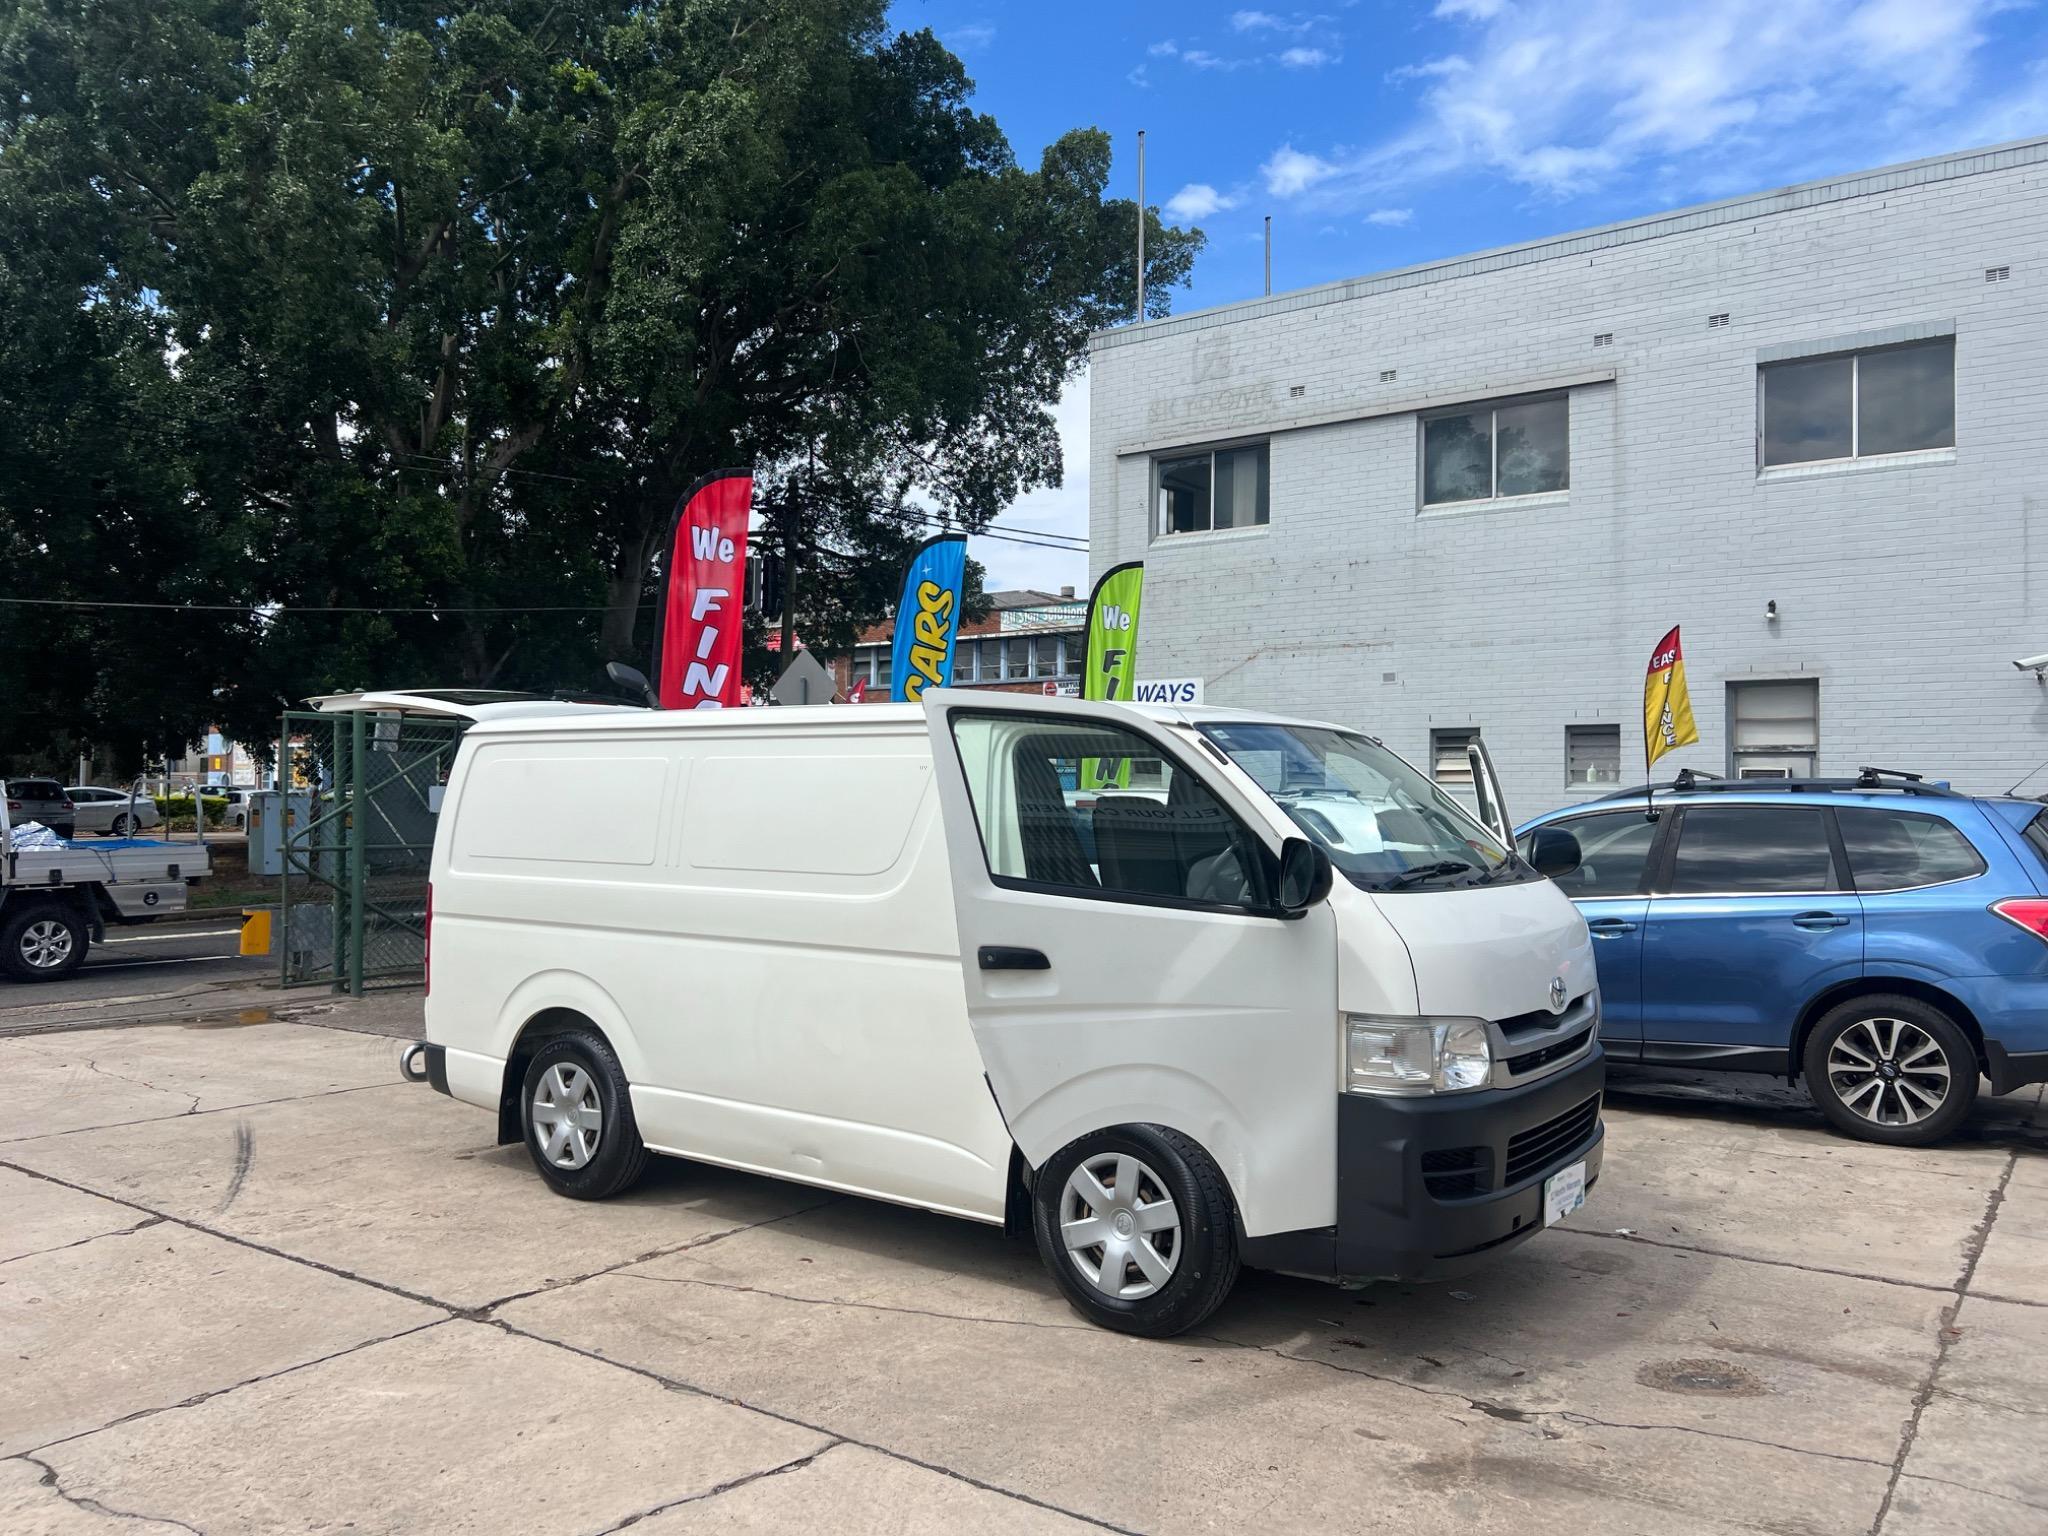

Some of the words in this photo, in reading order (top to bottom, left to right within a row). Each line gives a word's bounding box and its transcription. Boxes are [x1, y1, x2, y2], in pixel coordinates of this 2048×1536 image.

[691, 525, 735, 563] We
[1102, 605, 1131, 632] We
[1653, 650, 1675, 668] EAS
[1136, 683, 1196, 702] WAYS
